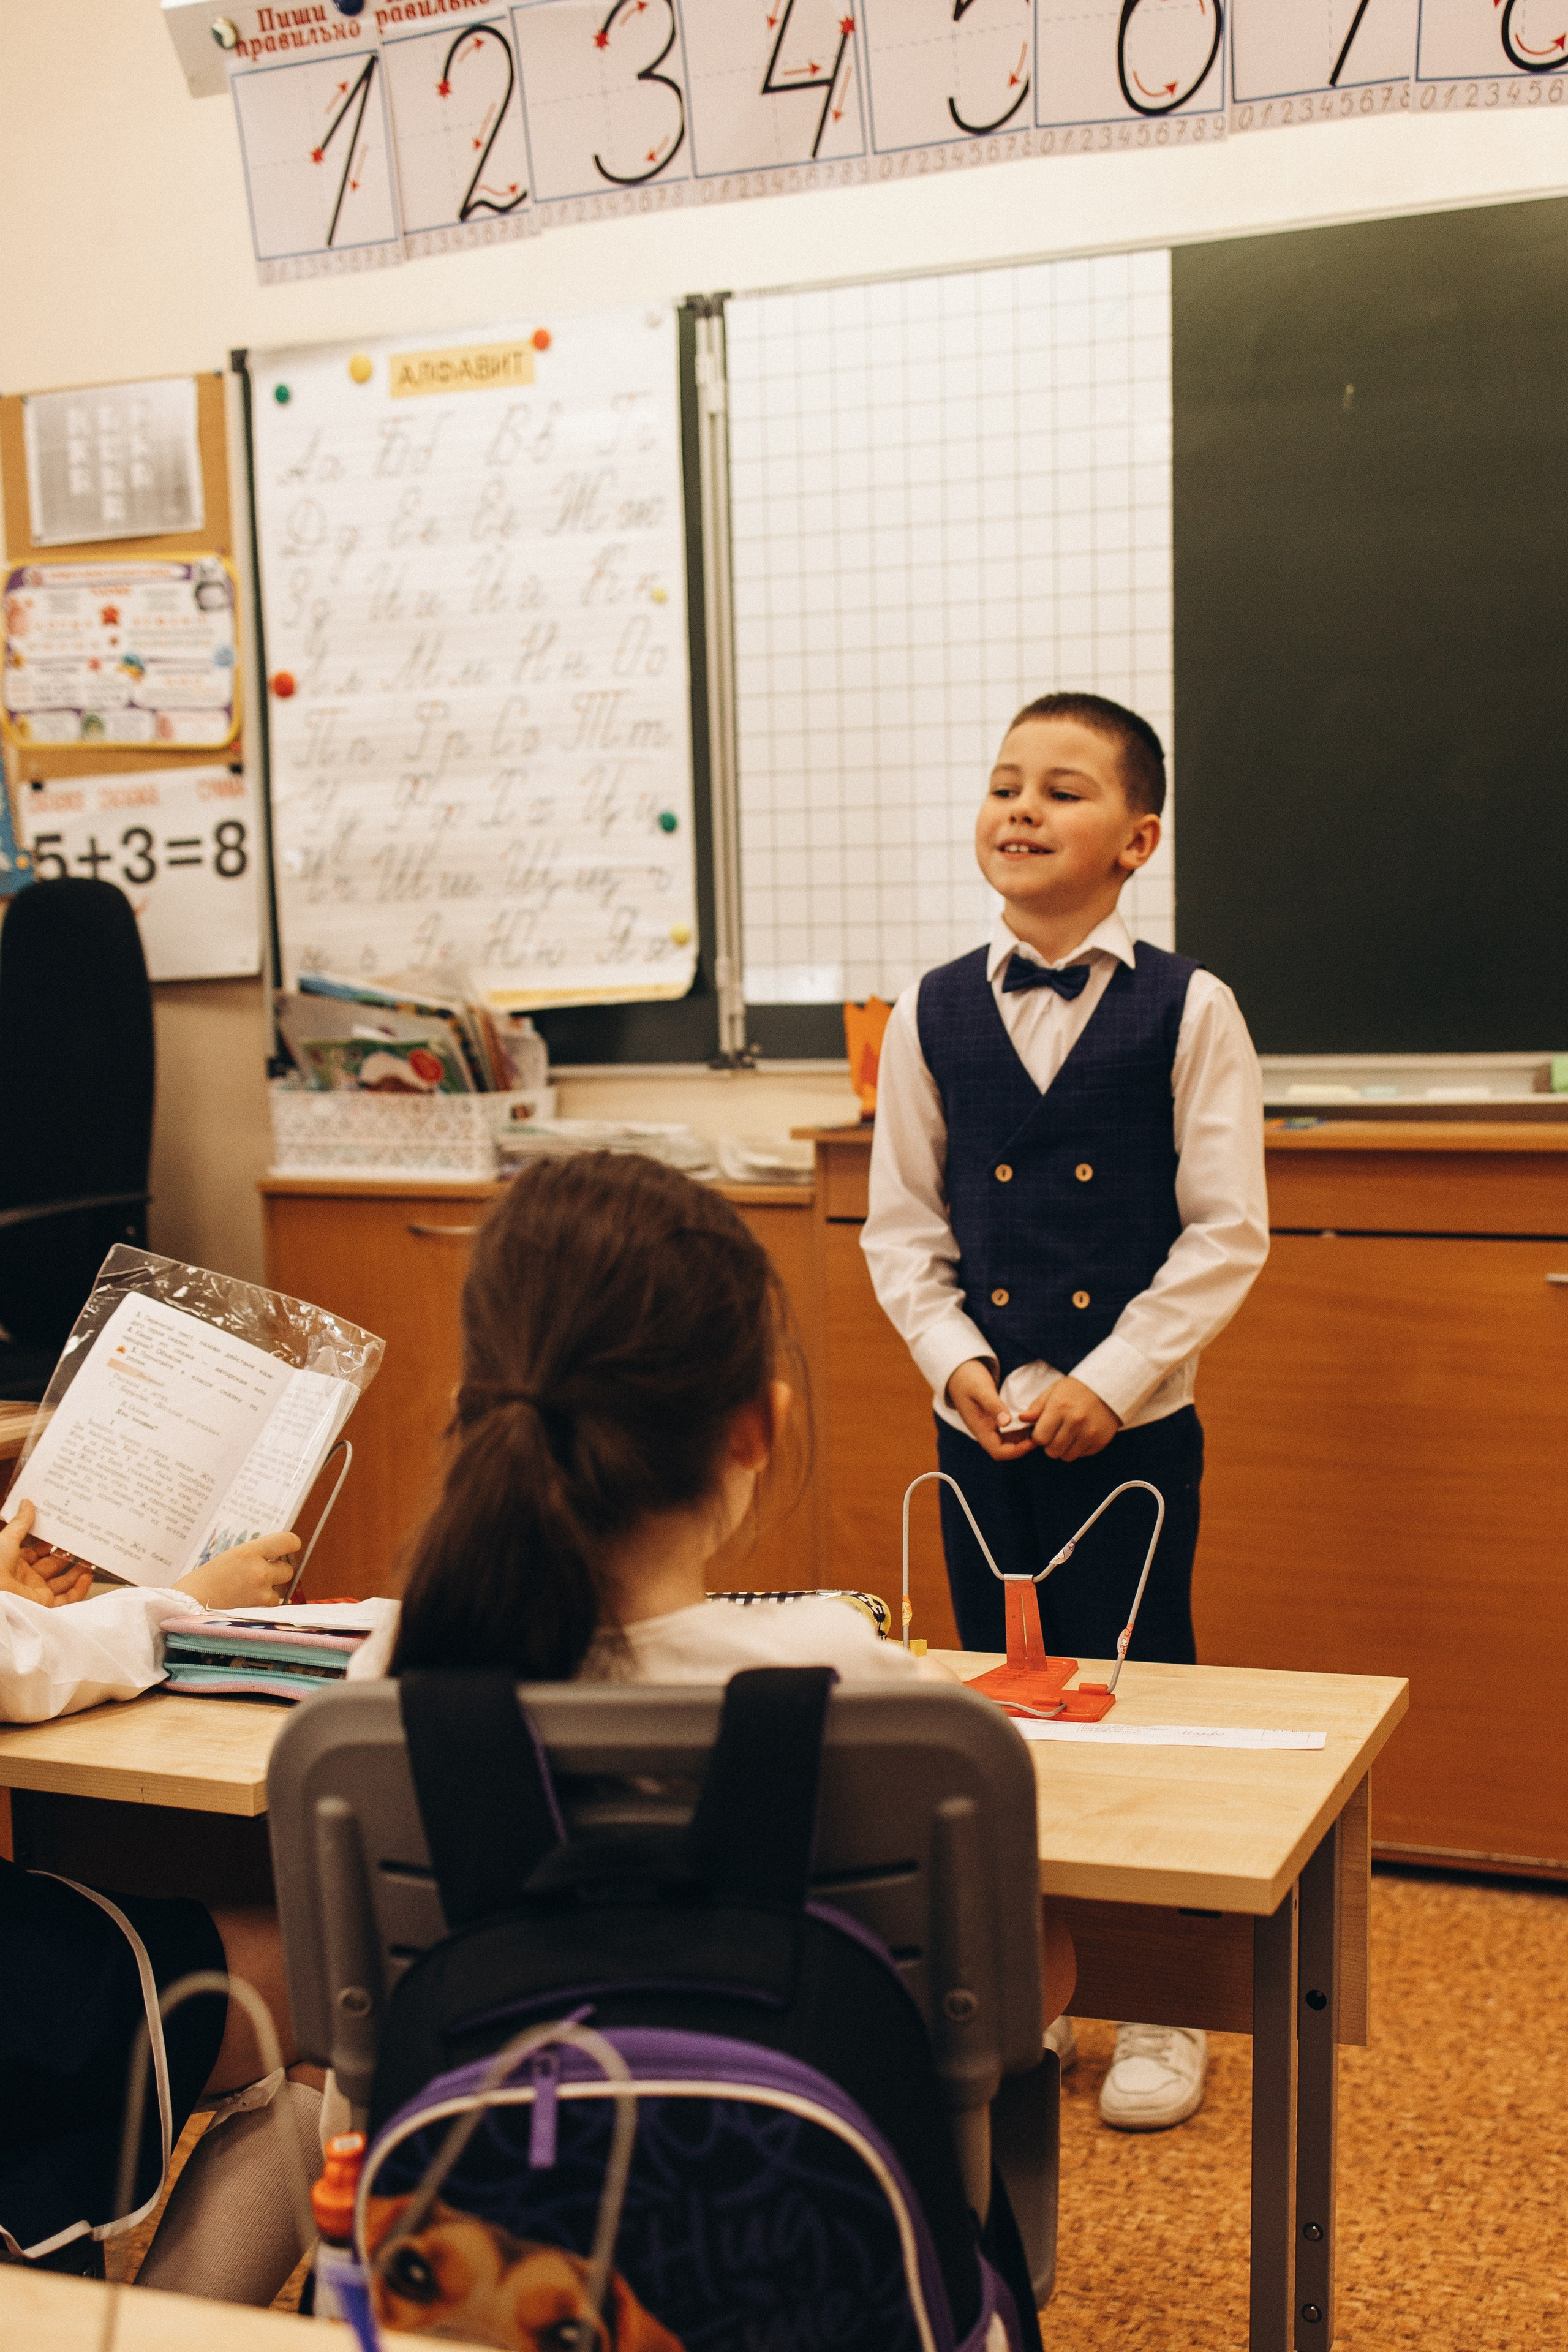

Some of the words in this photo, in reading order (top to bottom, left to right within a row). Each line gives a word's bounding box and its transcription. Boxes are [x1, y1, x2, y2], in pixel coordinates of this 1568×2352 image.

[257, 4, 326, 32] Пиши
[235, 20, 361, 62] правильно
[594, 0, 686, 185] 3
[761, 0, 851, 159] 4
[443, 24, 529, 222] 2
[317, 53, 379, 248] 1
[214, 1366, 247, 1385] авторская
[224, 1351, 255, 1370] действия
[219, 1389, 243, 1404] сказку
[146, 1446, 169, 1461] собаку
